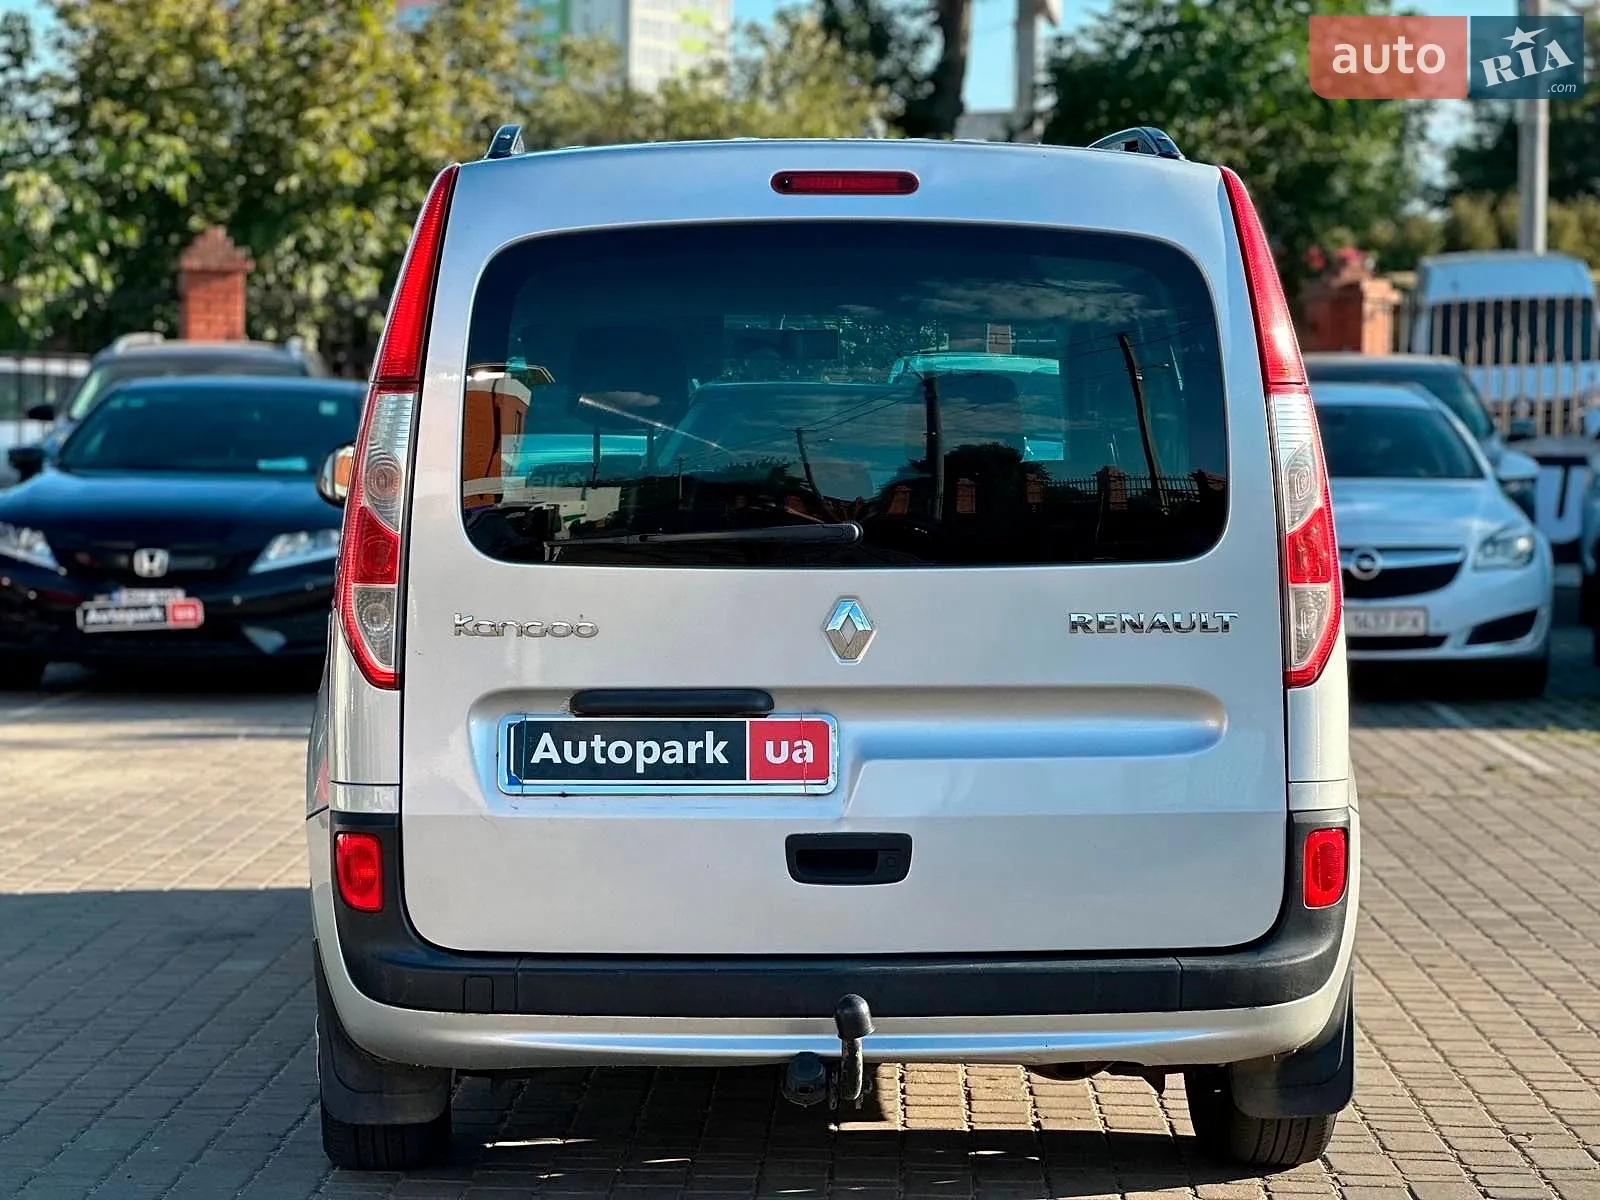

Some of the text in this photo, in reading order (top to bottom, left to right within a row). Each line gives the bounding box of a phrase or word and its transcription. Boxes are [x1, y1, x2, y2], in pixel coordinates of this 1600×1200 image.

[1068, 611, 1239, 634] RENAULT
[530, 730, 815, 774] Autopark ua
